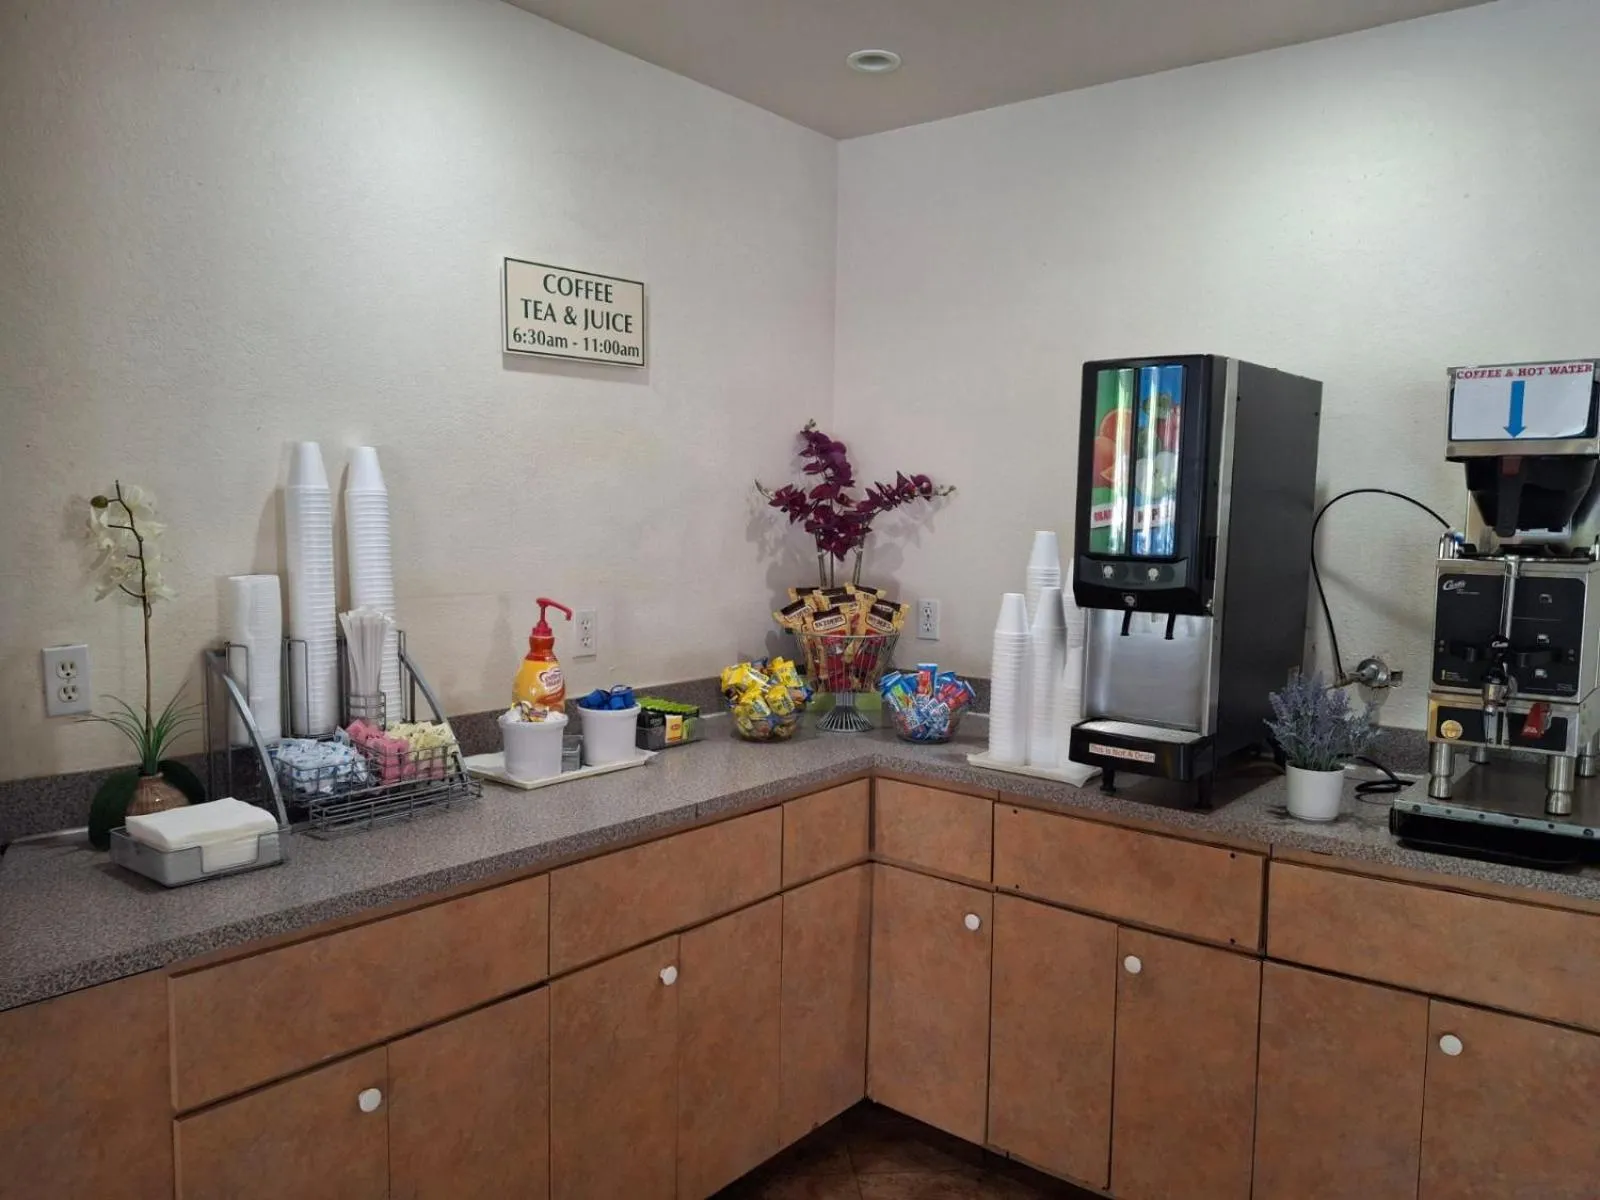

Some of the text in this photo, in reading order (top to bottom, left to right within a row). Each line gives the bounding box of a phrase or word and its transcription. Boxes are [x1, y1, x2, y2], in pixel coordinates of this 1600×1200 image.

[543, 274, 613, 303] COFFEE
[520, 298, 633, 334] TEA & JUICE
[512, 327, 568, 349] 6:30am
[584, 337, 640, 358] 11:00am
[1456, 364, 1593, 380] COFFEE & HOT WATER
